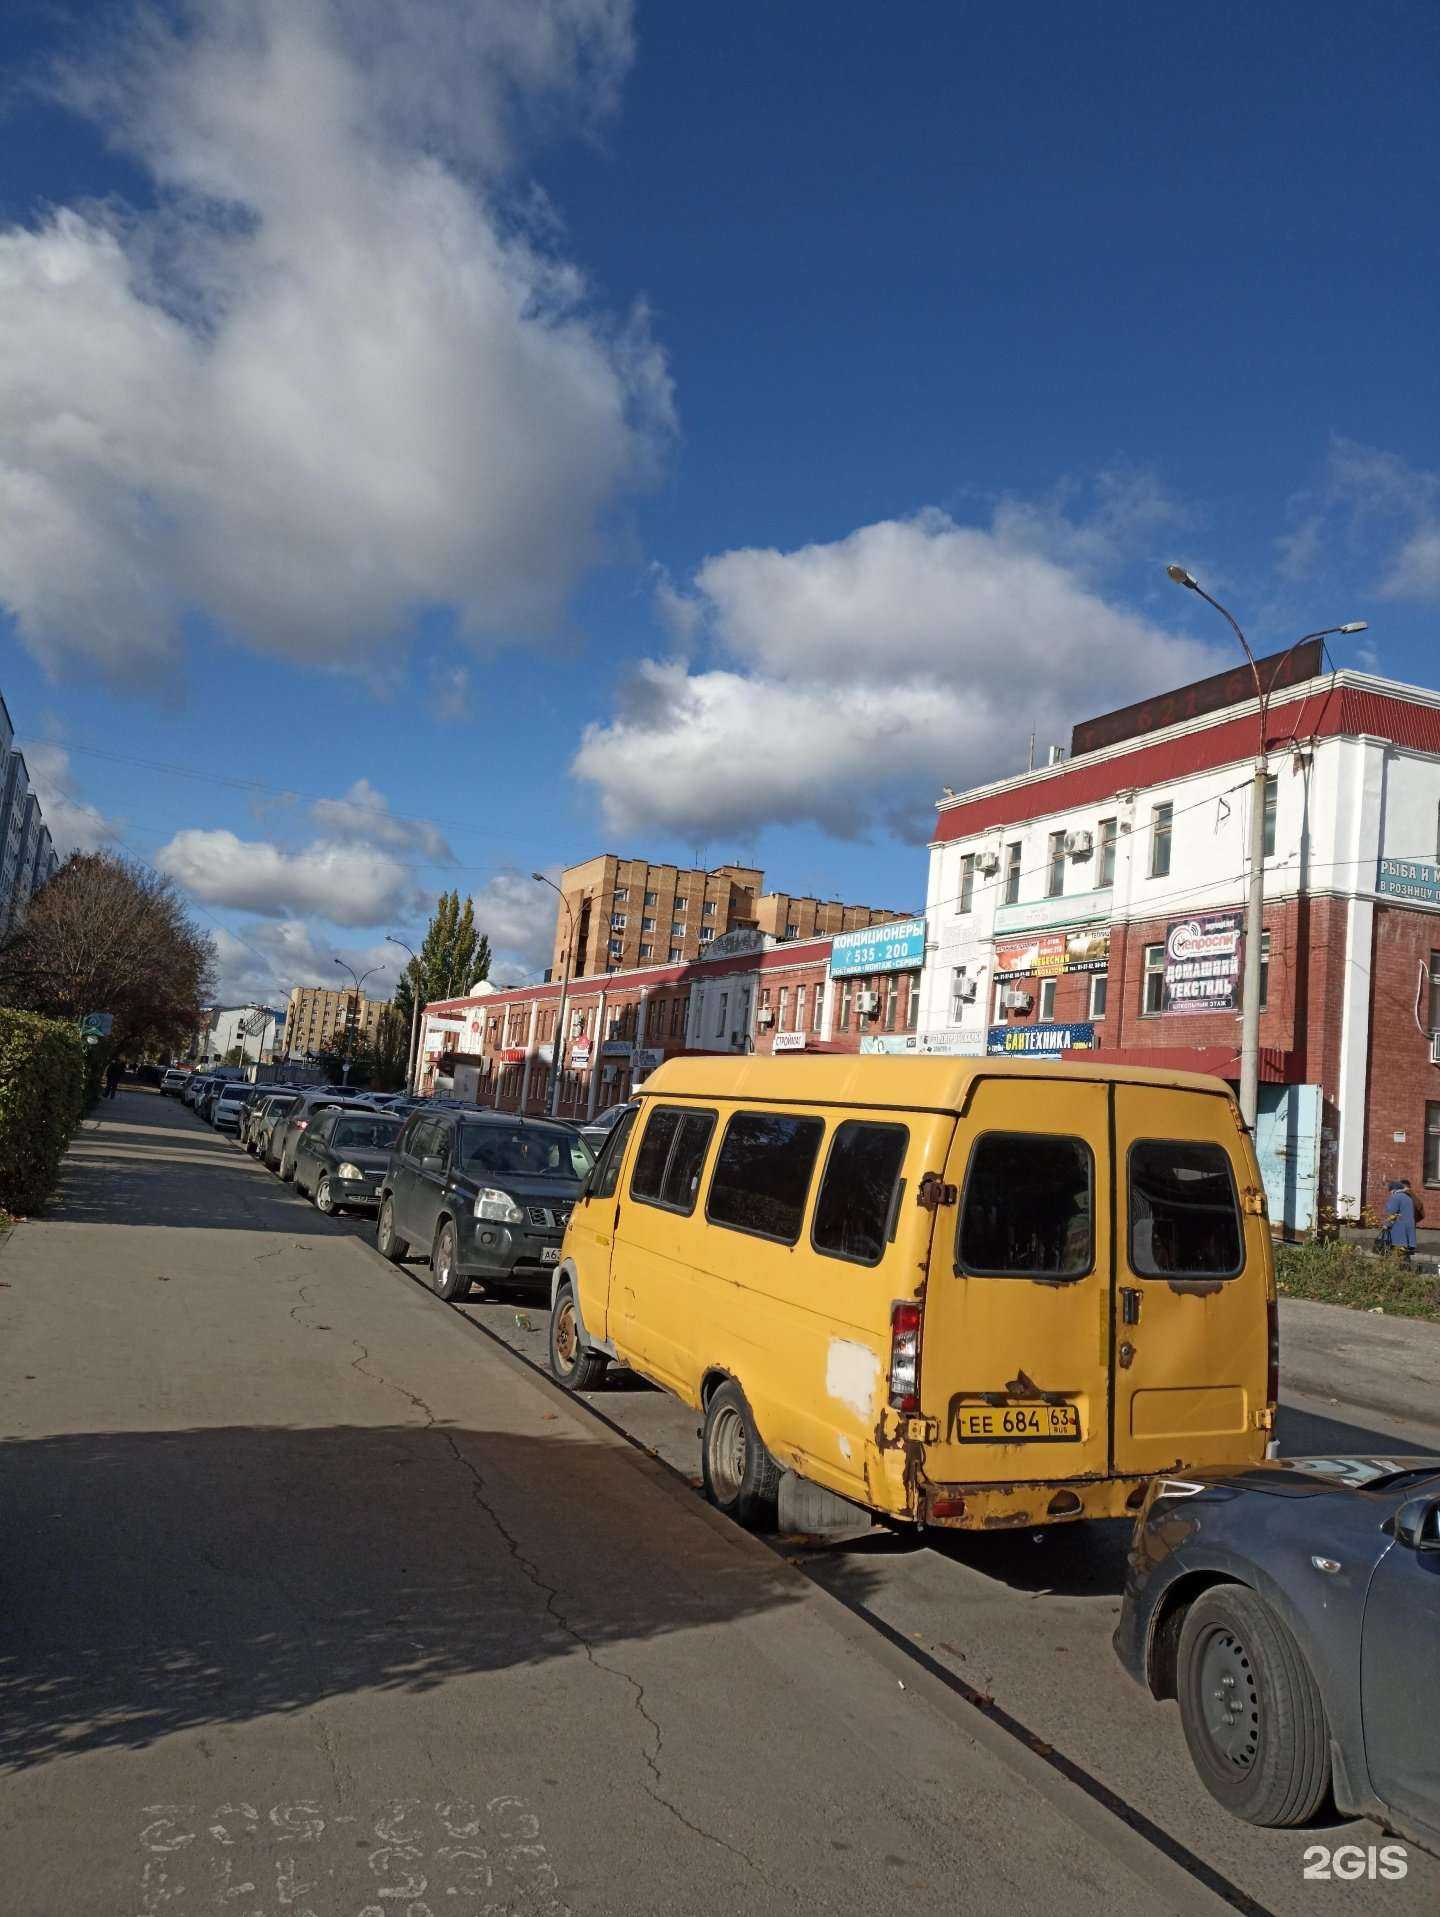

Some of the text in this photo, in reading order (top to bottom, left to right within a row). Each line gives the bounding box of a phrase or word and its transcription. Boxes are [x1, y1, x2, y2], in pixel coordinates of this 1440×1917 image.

[1381, 861, 1416, 879] РЫБА
[1381, 880, 1386, 891] В
[1390, 882, 1433, 899] РОЗНИЦУ
[833, 922, 924, 950] КОНДИЦИОНЕРЫ
[1166, 957, 1238, 983] ДОМАШНИЙ
[1169, 979, 1232, 998] ТЕКСТИЛЬ
[1006, 1031, 1071, 1050] САНТЕХНИКА
[1003, 1411, 1040, 1432] 684
[1051, 1409, 1068, 1426] 63
